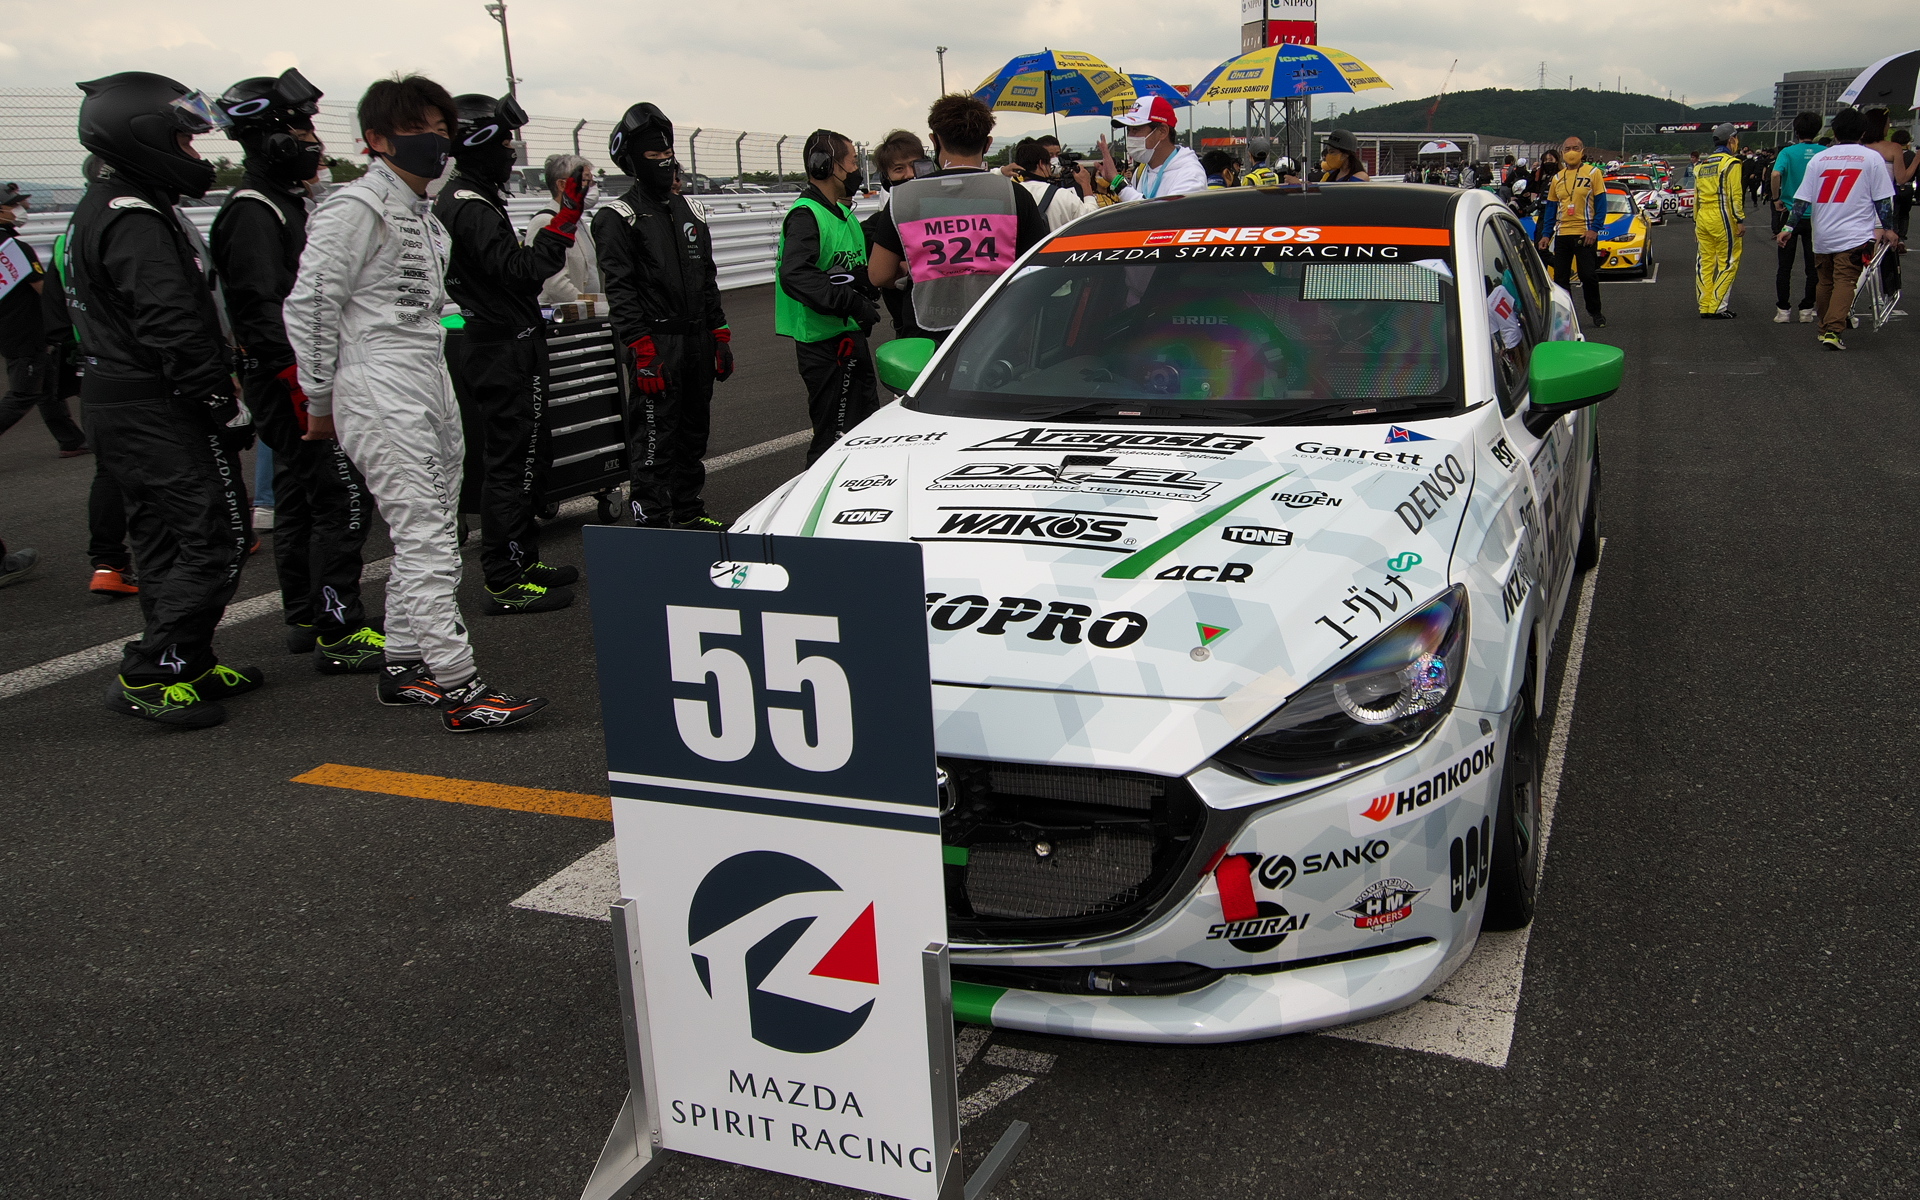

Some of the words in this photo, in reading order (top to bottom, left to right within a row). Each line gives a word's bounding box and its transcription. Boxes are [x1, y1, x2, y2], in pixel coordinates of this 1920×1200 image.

[1220, 86, 1242, 94] SEIWA
[1576, 177, 1591, 188] 72
[1816, 168, 1862, 204] 11
[1662, 198, 1676, 210] 66
[924, 218, 992, 236] MEDIA
[1178, 226, 1322, 244] ENEOS
[922, 236, 999, 266] 324
[1064, 248, 1162, 264] MAZDA
[1174, 246, 1266, 258] SPIRIT
[1280, 246, 1400, 258] RACING
[314, 272, 324, 308] MAZDA
[312, 310, 322, 340] SPIRIT
[1172, 315, 1229, 326] BRIDE
[312, 341, 322, 375] RACING
[532, 375, 542, 420] MAZDA
[838, 397, 847, 426] SPIRIT
[644, 430, 656, 466] RACING
[844, 432, 948, 447] Garrett
[970, 428, 1256, 453] Aragosta
[1291, 452, 1366, 466] ADVANCING
[1369, 461, 1420, 472] MOTION
[1294, 440, 1424, 468] Garrett
[208, 434, 232, 487] MAZDA
[225, 491, 244, 532] SPIRIT
[332, 444, 351, 481] SPIRIT
[346, 484, 360, 530] RACING
[424, 456, 450, 516] MAZDA
[523, 457, 534, 492] RACIN
[839, 478, 898, 488] IBIDEN
[1024, 484, 1082, 492] BRAKE
[1088, 486, 1203, 500] TECHNOLOGY
[1270, 491, 1342, 508] IBIDEN
[1394, 453, 1467, 536] DENSO
[838, 511, 890, 523] TONE
[937, 513, 1128, 542] WAKO'S
[1226, 528, 1288, 544] TONE
[1155, 562, 1254, 584] 4CR
[666, 604, 854, 773] 55
[1302, 840, 1390, 875] SANKO
[1355, 878, 1402, 904] POWERED
[1400, 880, 1415, 892] BY
[1206, 913, 1310, 940] SHORAI
[1366, 910, 1404, 927] RACERS
[728, 1068, 864, 1118] MAZDA
[671, 1100, 774, 1143] SPIRIT
[792, 1123, 932, 1174] RACING
